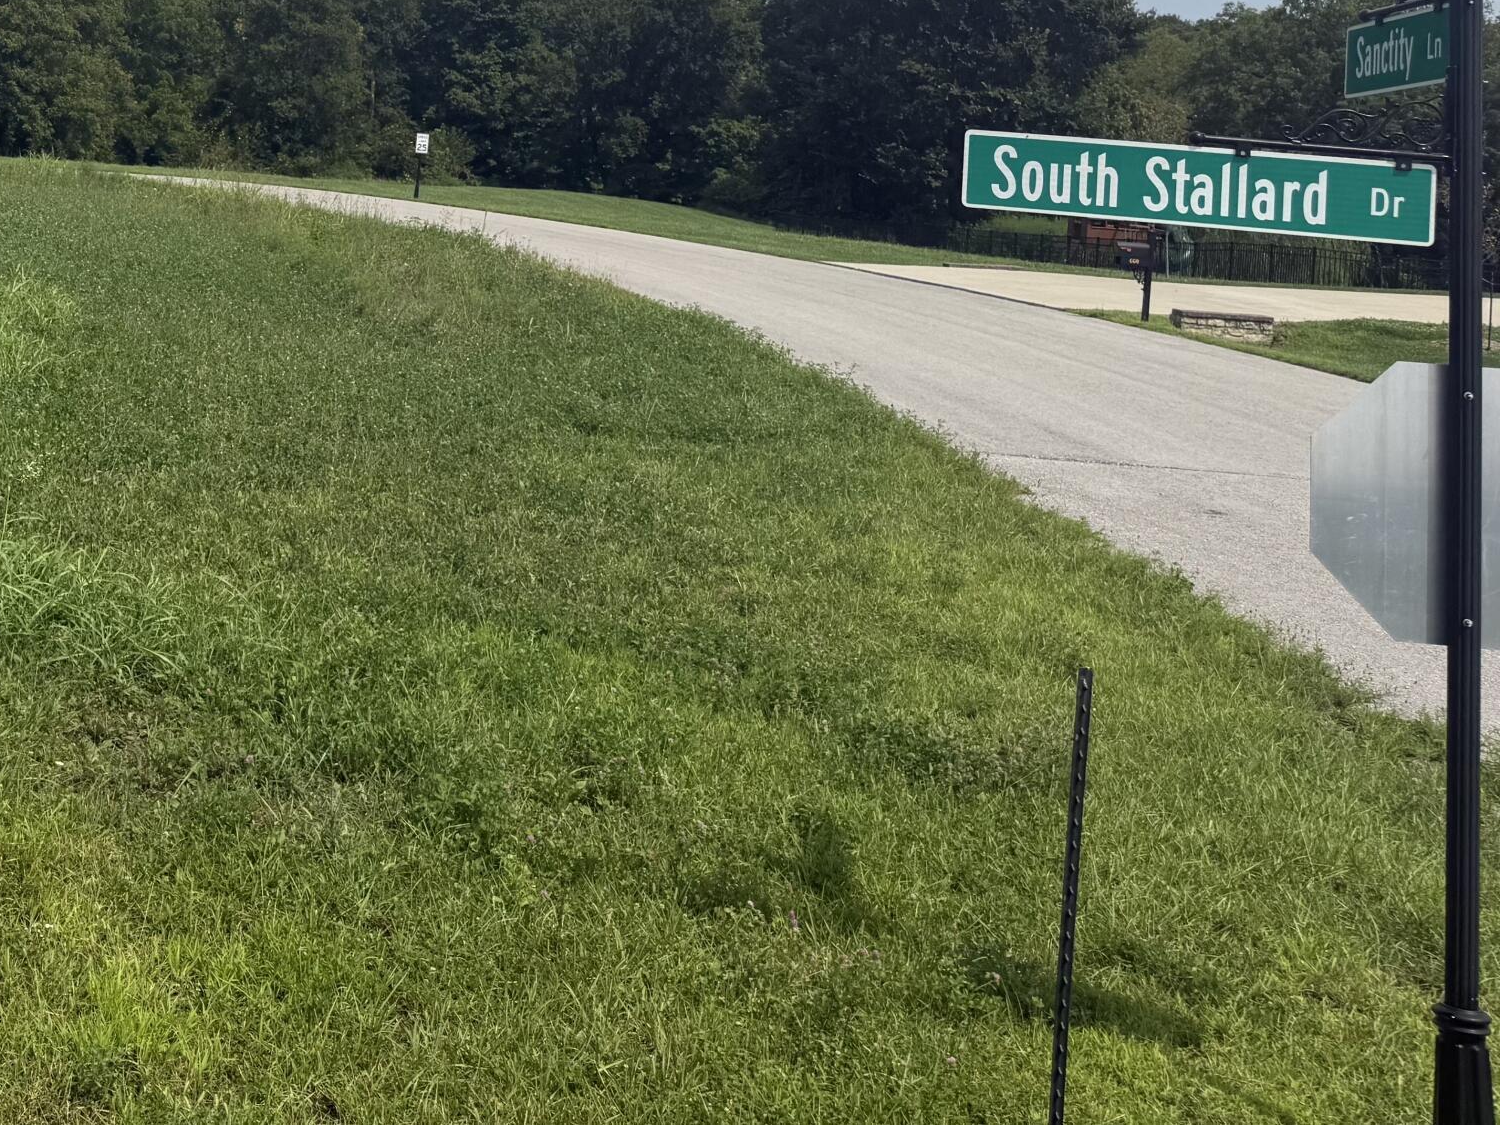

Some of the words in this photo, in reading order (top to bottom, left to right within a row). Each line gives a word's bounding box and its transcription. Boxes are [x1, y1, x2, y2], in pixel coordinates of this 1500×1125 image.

[1355, 27, 1414, 81] Sanctity
[1426, 32, 1442, 60] Ln
[417, 143, 427, 152] 25
[990, 144, 1119, 208] South
[1142, 156, 1328, 225] Stallard
[1370, 187, 1405, 218] Dr
